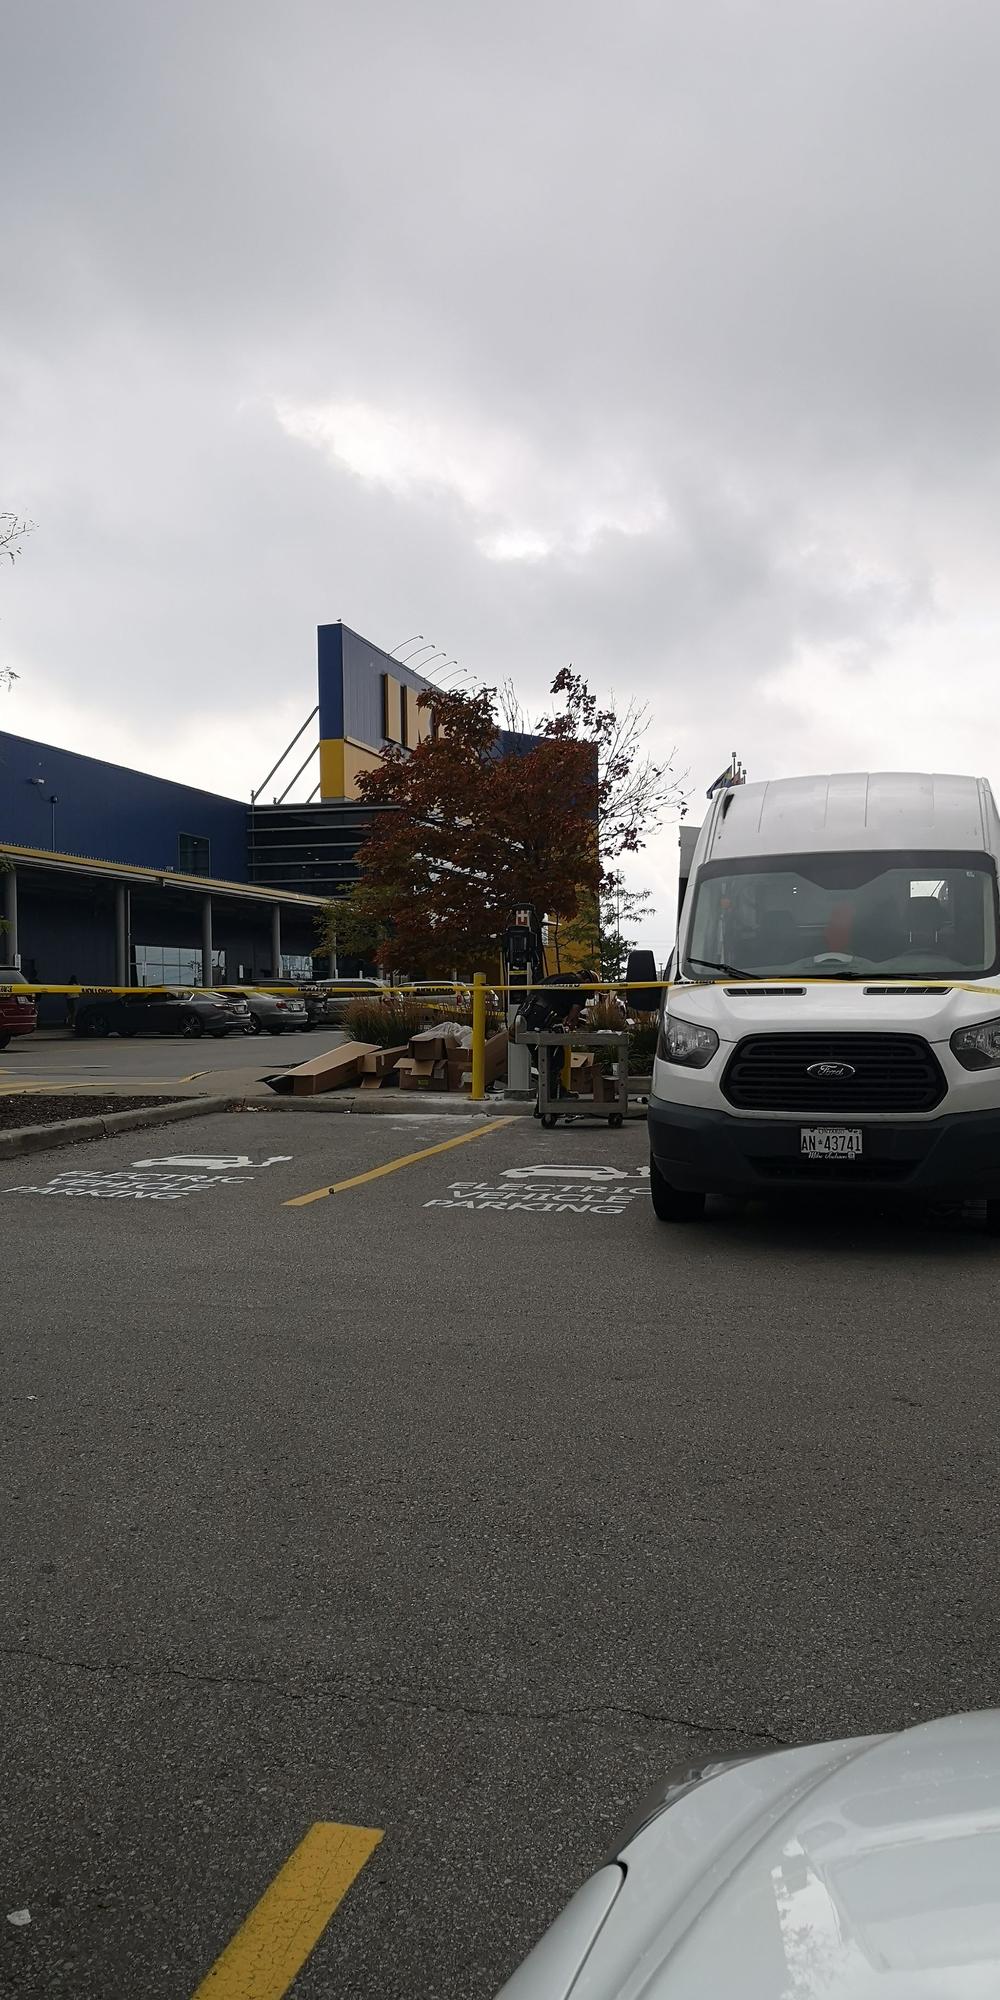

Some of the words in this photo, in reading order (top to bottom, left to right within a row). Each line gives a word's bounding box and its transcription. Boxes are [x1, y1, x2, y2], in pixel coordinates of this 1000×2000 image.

[817, 1064, 844, 1076] Ford
[824, 1135, 861, 1151] 43741
[57, 1170, 255, 1184] ELECTRIC
[47, 1178, 216, 1191] VEHICLE
[447, 1181, 652, 1195] ELECTRIC
[1, 1186, 190, 1200] PARKING
[453, 1190, 635, 1204] VEHICLE
[422, 1199, 627, 1214] PARKING
